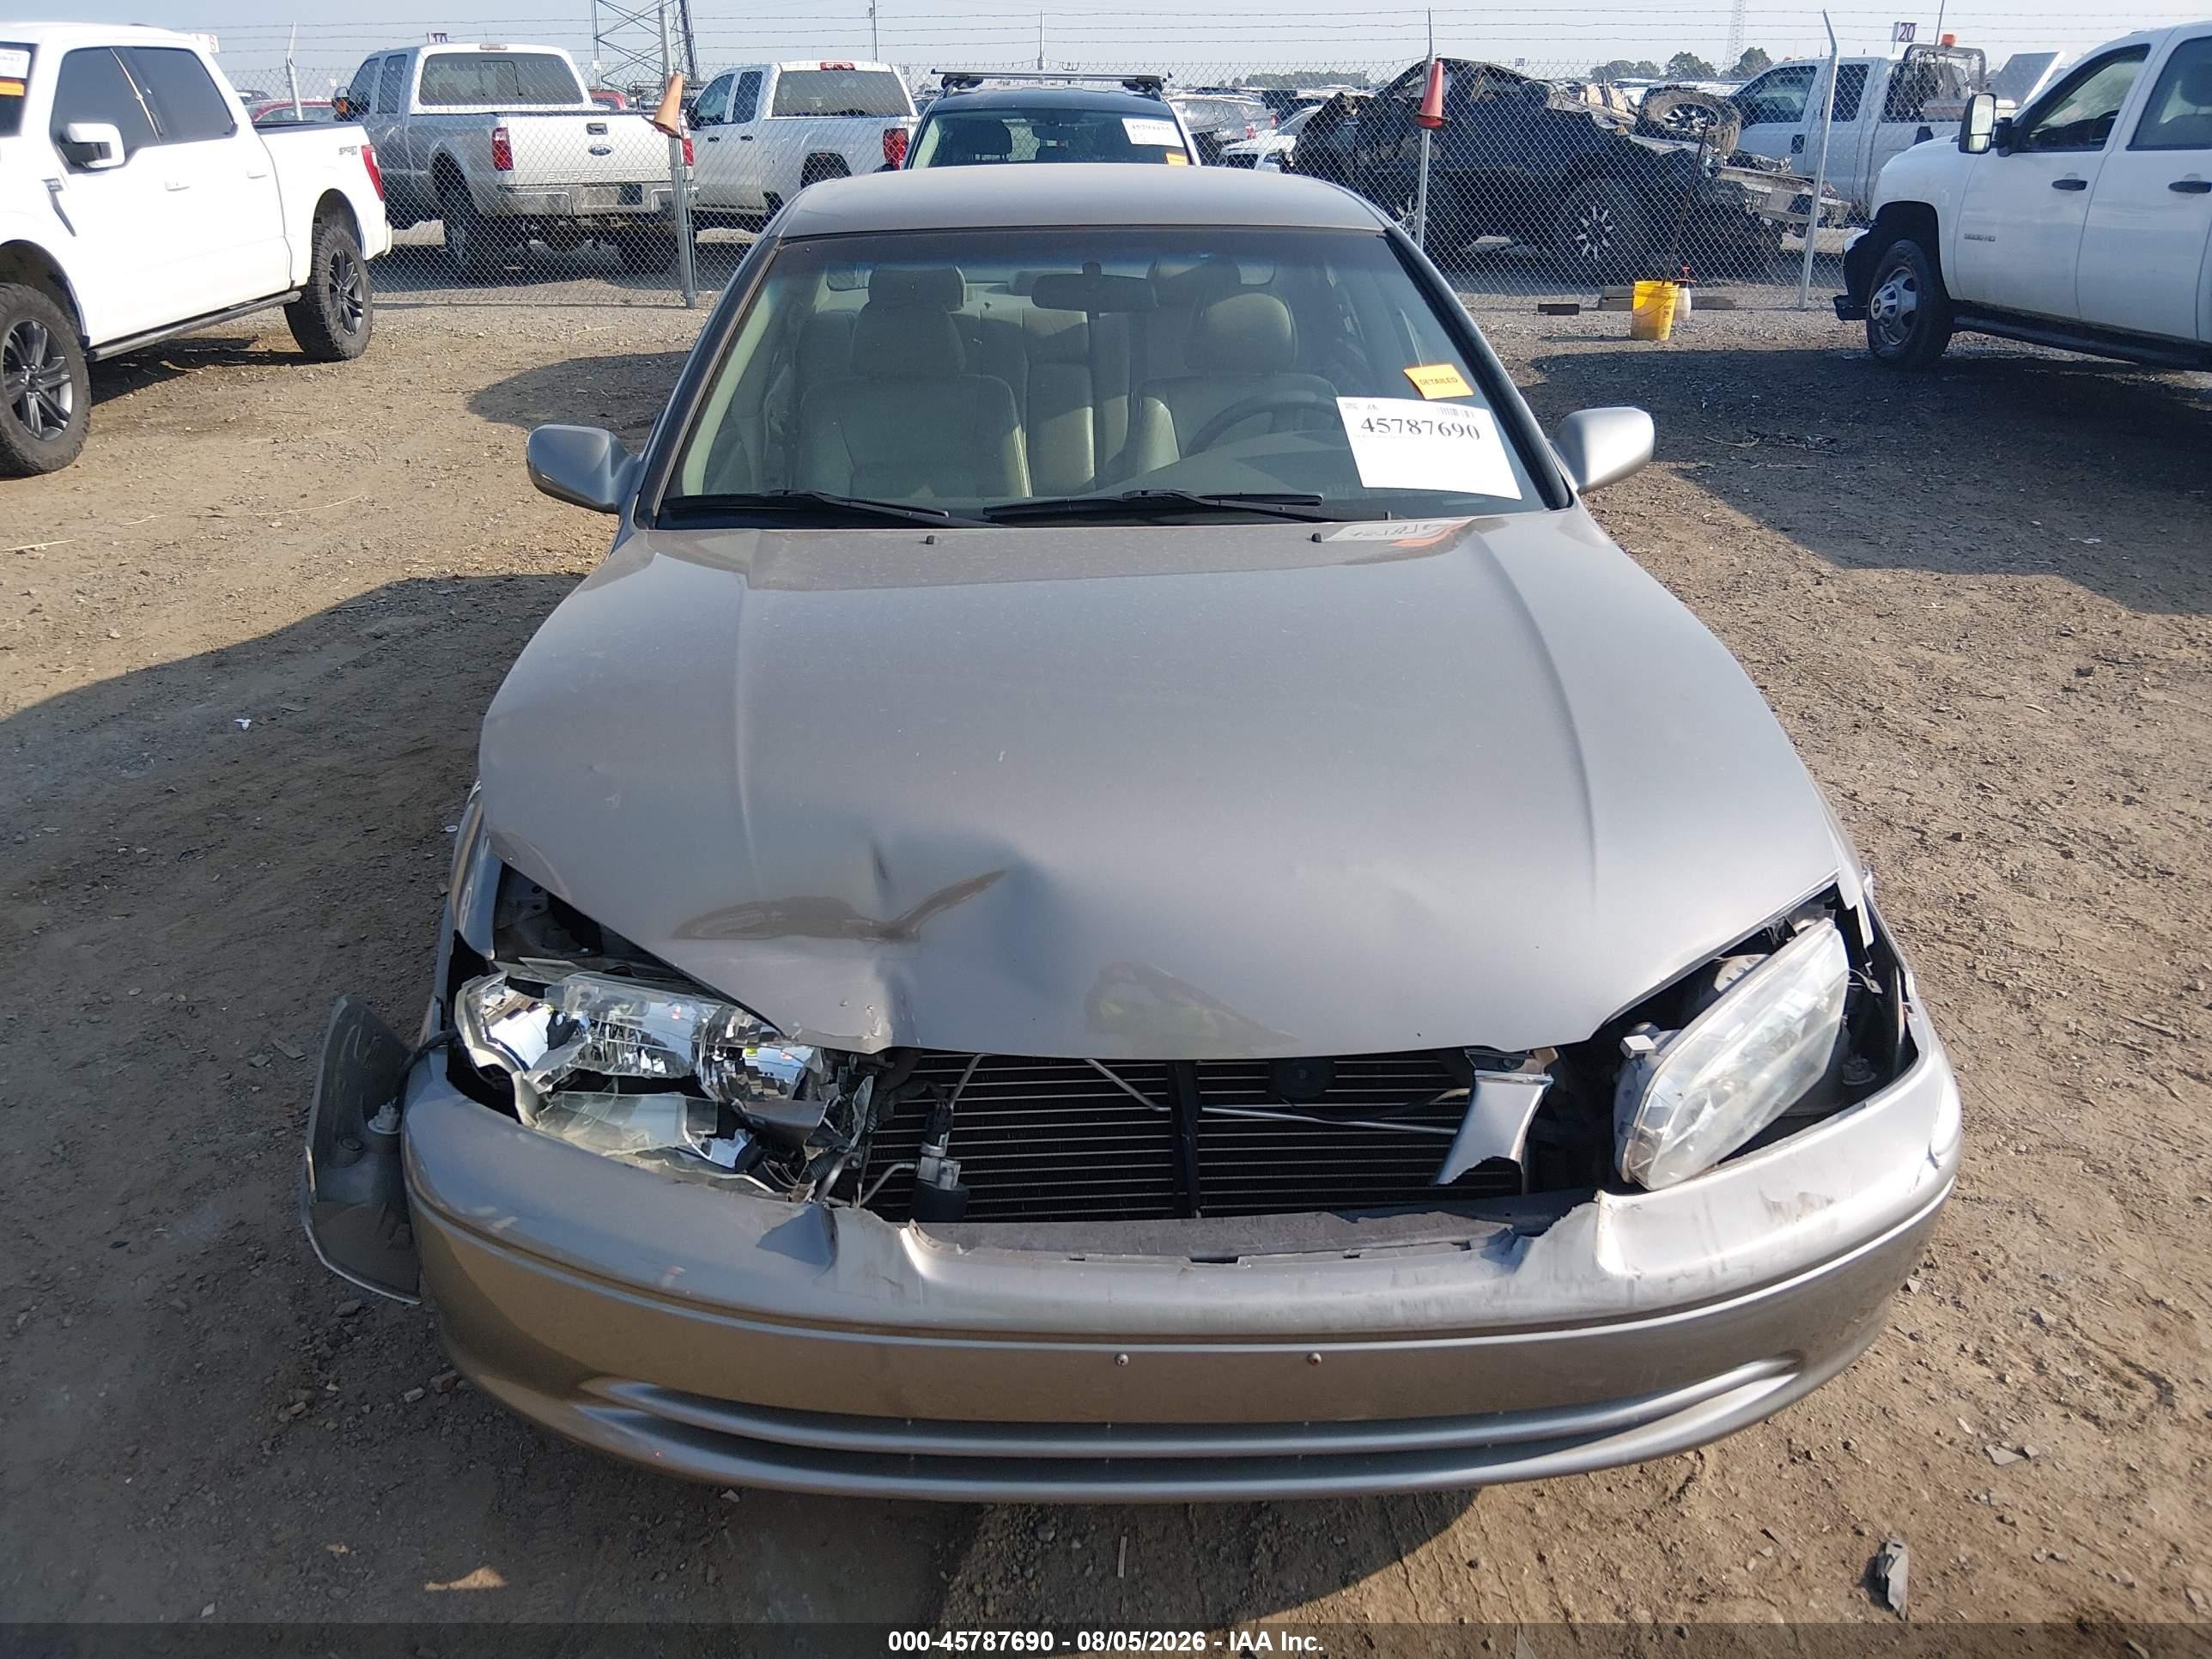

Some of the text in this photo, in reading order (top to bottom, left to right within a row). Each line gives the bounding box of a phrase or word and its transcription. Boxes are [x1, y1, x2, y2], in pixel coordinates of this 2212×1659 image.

[1898, 22, 1916, 42] 20
[546, 172, 604, 182] SUPER
[1419, 377, 1458, 386] DETAILED
[1361, 417, 1480, 441] 45787690
